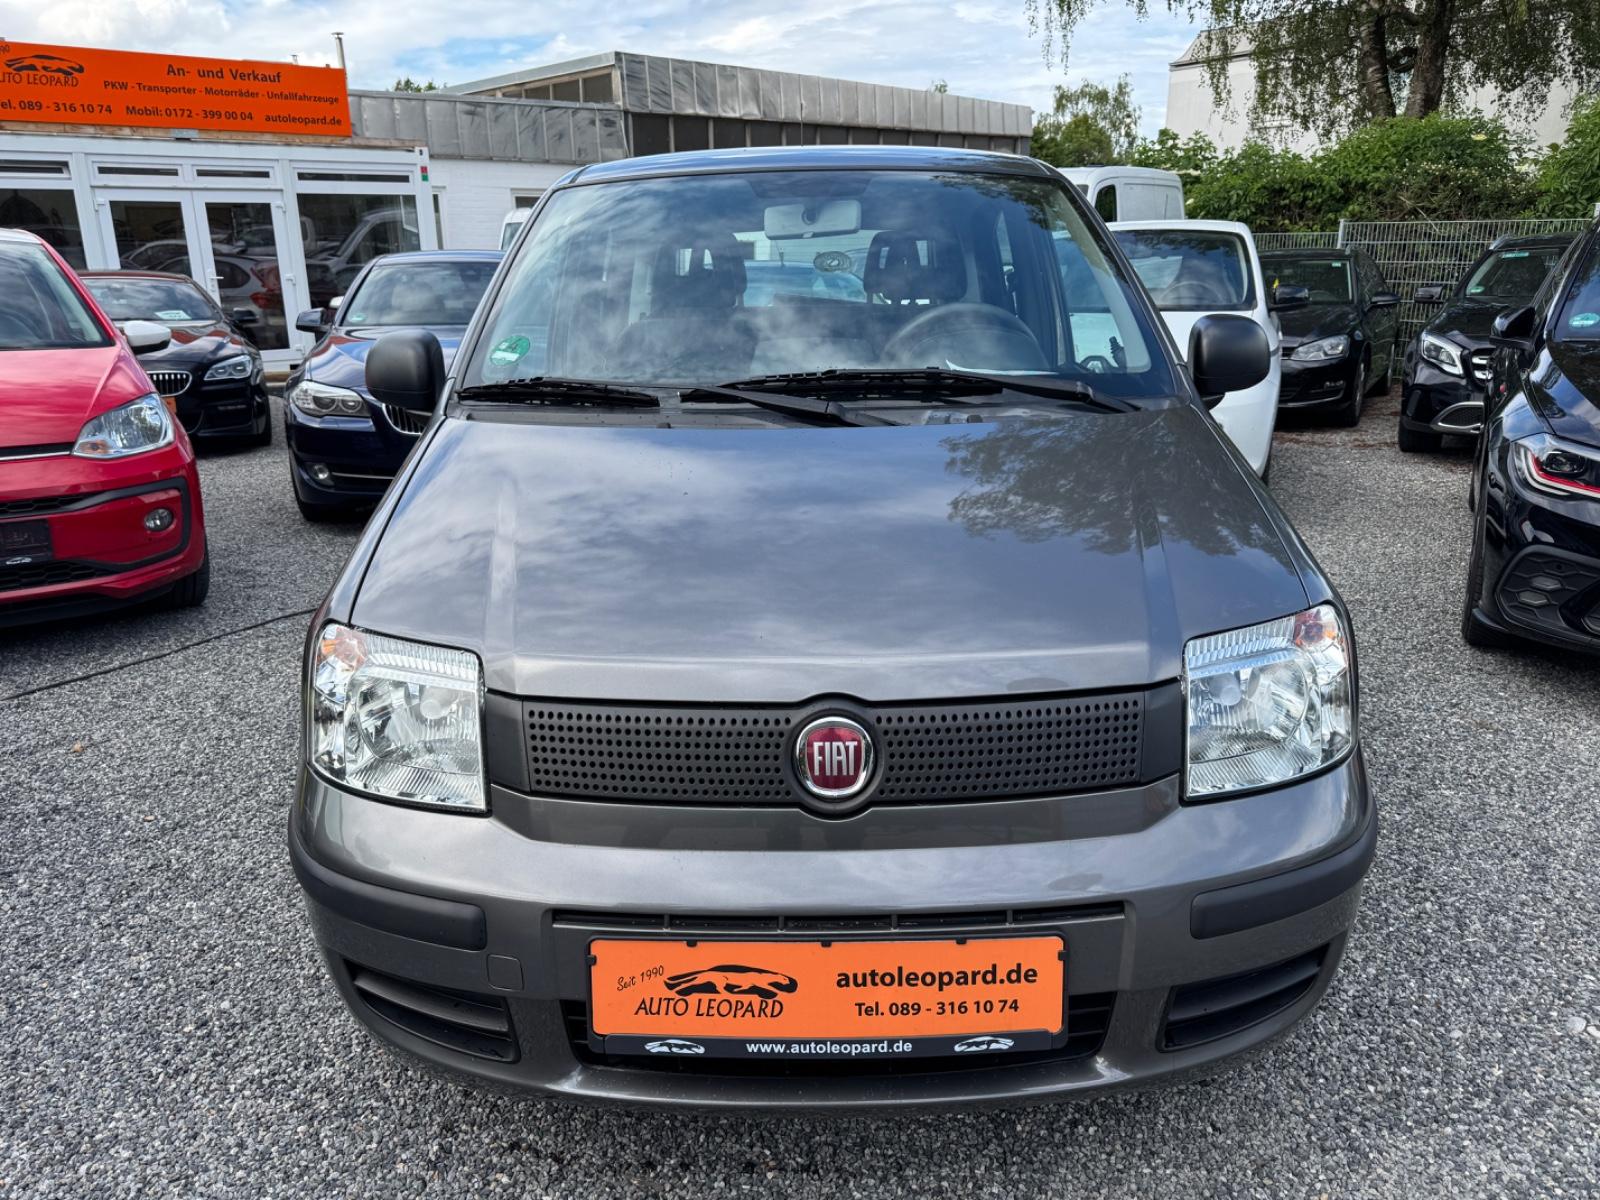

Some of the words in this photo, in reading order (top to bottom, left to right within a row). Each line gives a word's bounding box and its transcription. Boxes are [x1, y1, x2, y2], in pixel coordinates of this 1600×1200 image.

[27, 72, 79, 87] LEOPARD
[166, 64, 191, 77] An-
[197, 66, 225, 79] und
[229, 68, 282, 83] Verkauf
[103, 80, 129, 90] PKW
[136, 82, 197, 95] Transporter
[204, 86, 260, 99] Motorräder
[267, 90, 339, 105] Unfallfahrzeuge
[0, 99, 16, 110] el.
[19, 100, 42, 111] 089
[53, 102, 77, 113] 316
[80, 103, 94, 114] 10
[97, 103, 113, 114] 74
[125, 105, 162, 117] Mobil:
[164, 107, 193, 118] 0172
[202, 109, 222, 119] 399
[224, 110, 238, 120] 00
[240, 111, 253, 121] 04
[264, 113, 342, 126] autoleopard.de
[812, 741, 858, 776] FIAT
[616, 976, 636, 992] Seit
[640, 965, 664, 983] 1990
[836, 962, 1038, 991] autoleopard.de
[634, 997, 689, 1016] AUTO
[695, 998, 784, 1018] LEOPARD
[855, 1002, 885, 1017] Tel.
[889, 1002, 922, 1017] 089
[936, 1001, 968, 1016] 316
[973, 1000, 994, 1014] 10
[998, 999, 1019, 1013] 74
[745, 1040, 913, 1056] www.autoleopard.de
